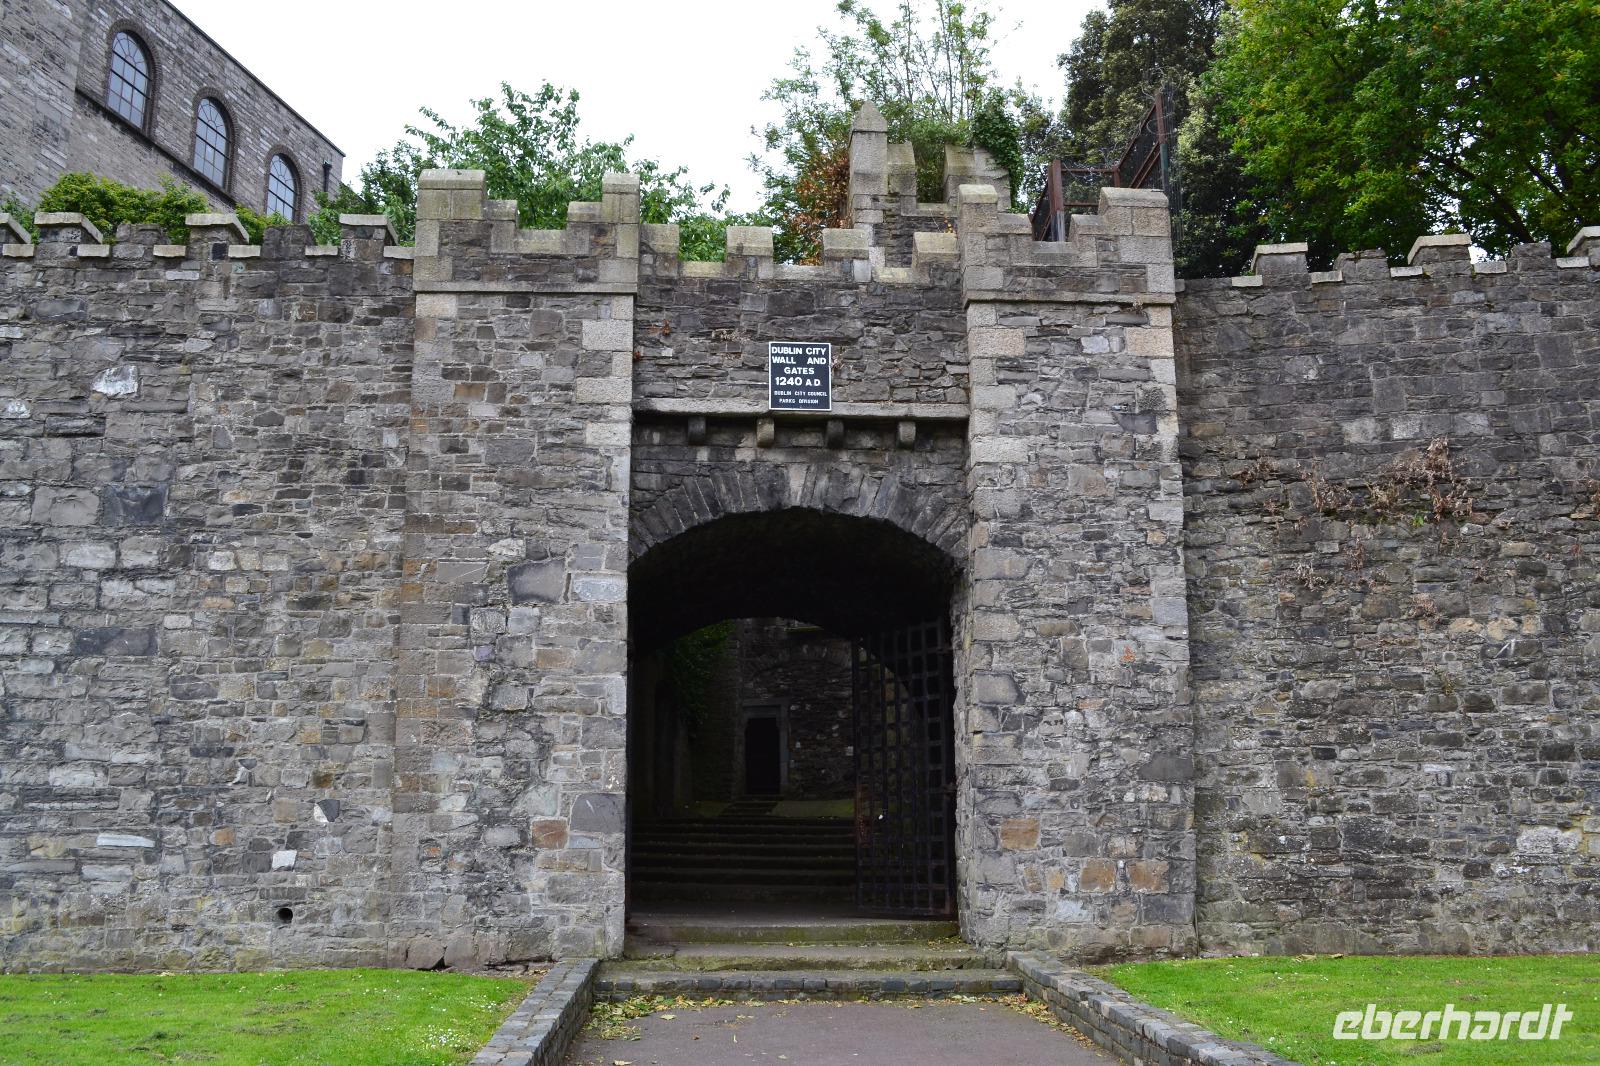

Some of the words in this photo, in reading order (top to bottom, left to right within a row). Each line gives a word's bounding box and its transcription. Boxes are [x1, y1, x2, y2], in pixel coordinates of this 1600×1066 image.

[772, 346, 802, 354] DUBLIN
[772, 356, 796, 364] WALL
[776, 376, 802, 386] 1240
